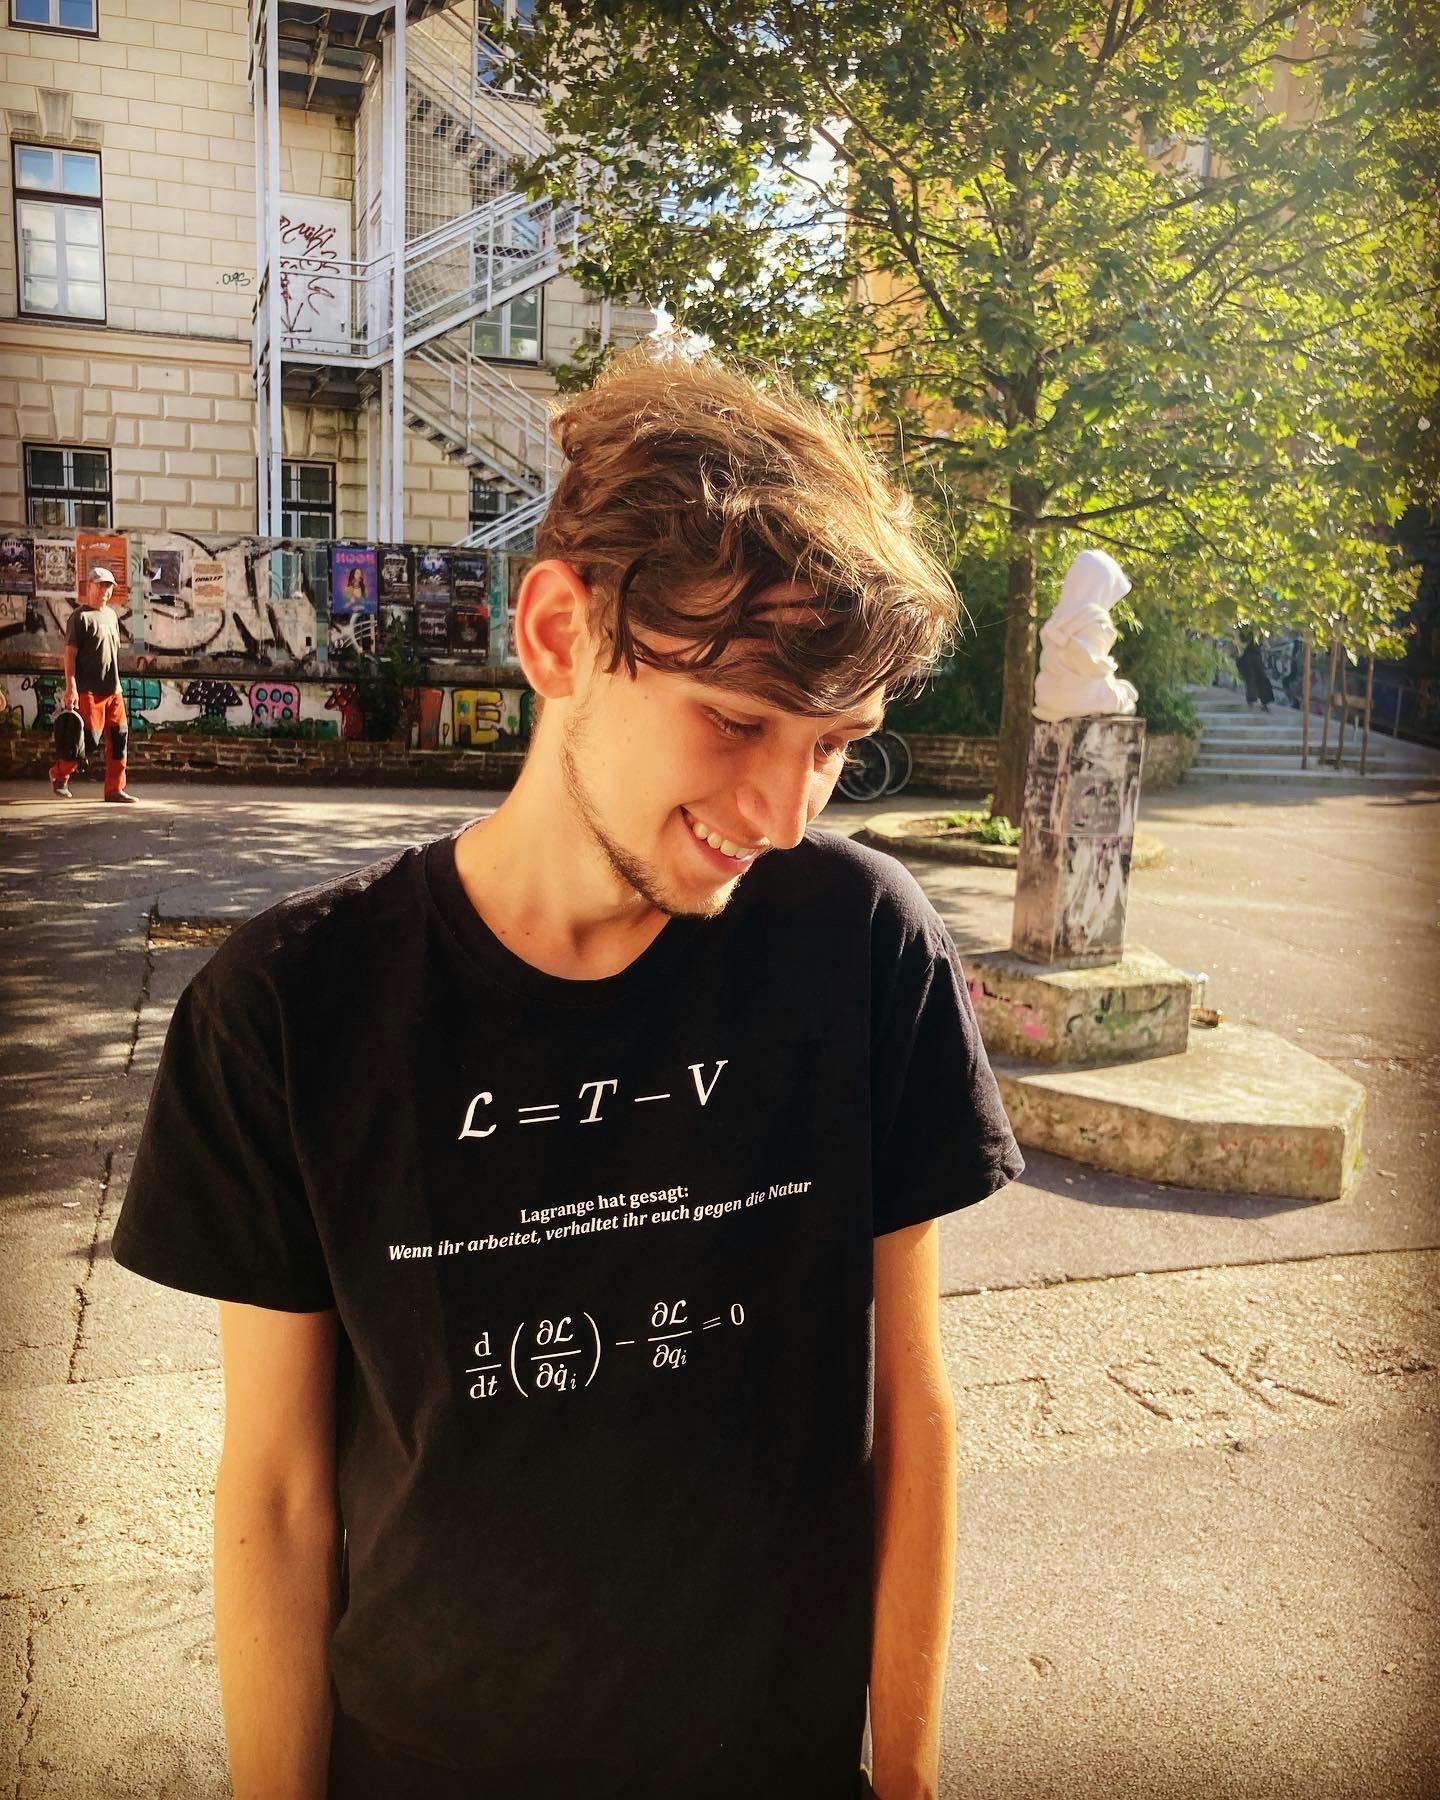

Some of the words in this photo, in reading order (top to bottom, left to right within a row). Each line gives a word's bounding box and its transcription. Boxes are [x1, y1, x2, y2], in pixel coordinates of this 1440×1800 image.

[578, 1079, 618, 1124] T
[688, 1060, 729, 1106] V
[388, 1244, 433, 1261] Wenn
[437, 1239, 465, 1256] ihr
[467, 1230, 542, 1253] arbeitet,
[545, 1215, 619, 1241] verhaltet
[622, 1211, 649, 1229] ihr
[651, 1204, 690, 1224] euch
[693, 1199, 742, 1222] gegen
[745, 1190, 766, 1208] die
[768, 1181, 812, 1200] Natur
[520, 1200, 595, 1225] Lagrange
[598, 1193, 627, 1210] hat
[630, 1185, 690, 1209] gesagt:
